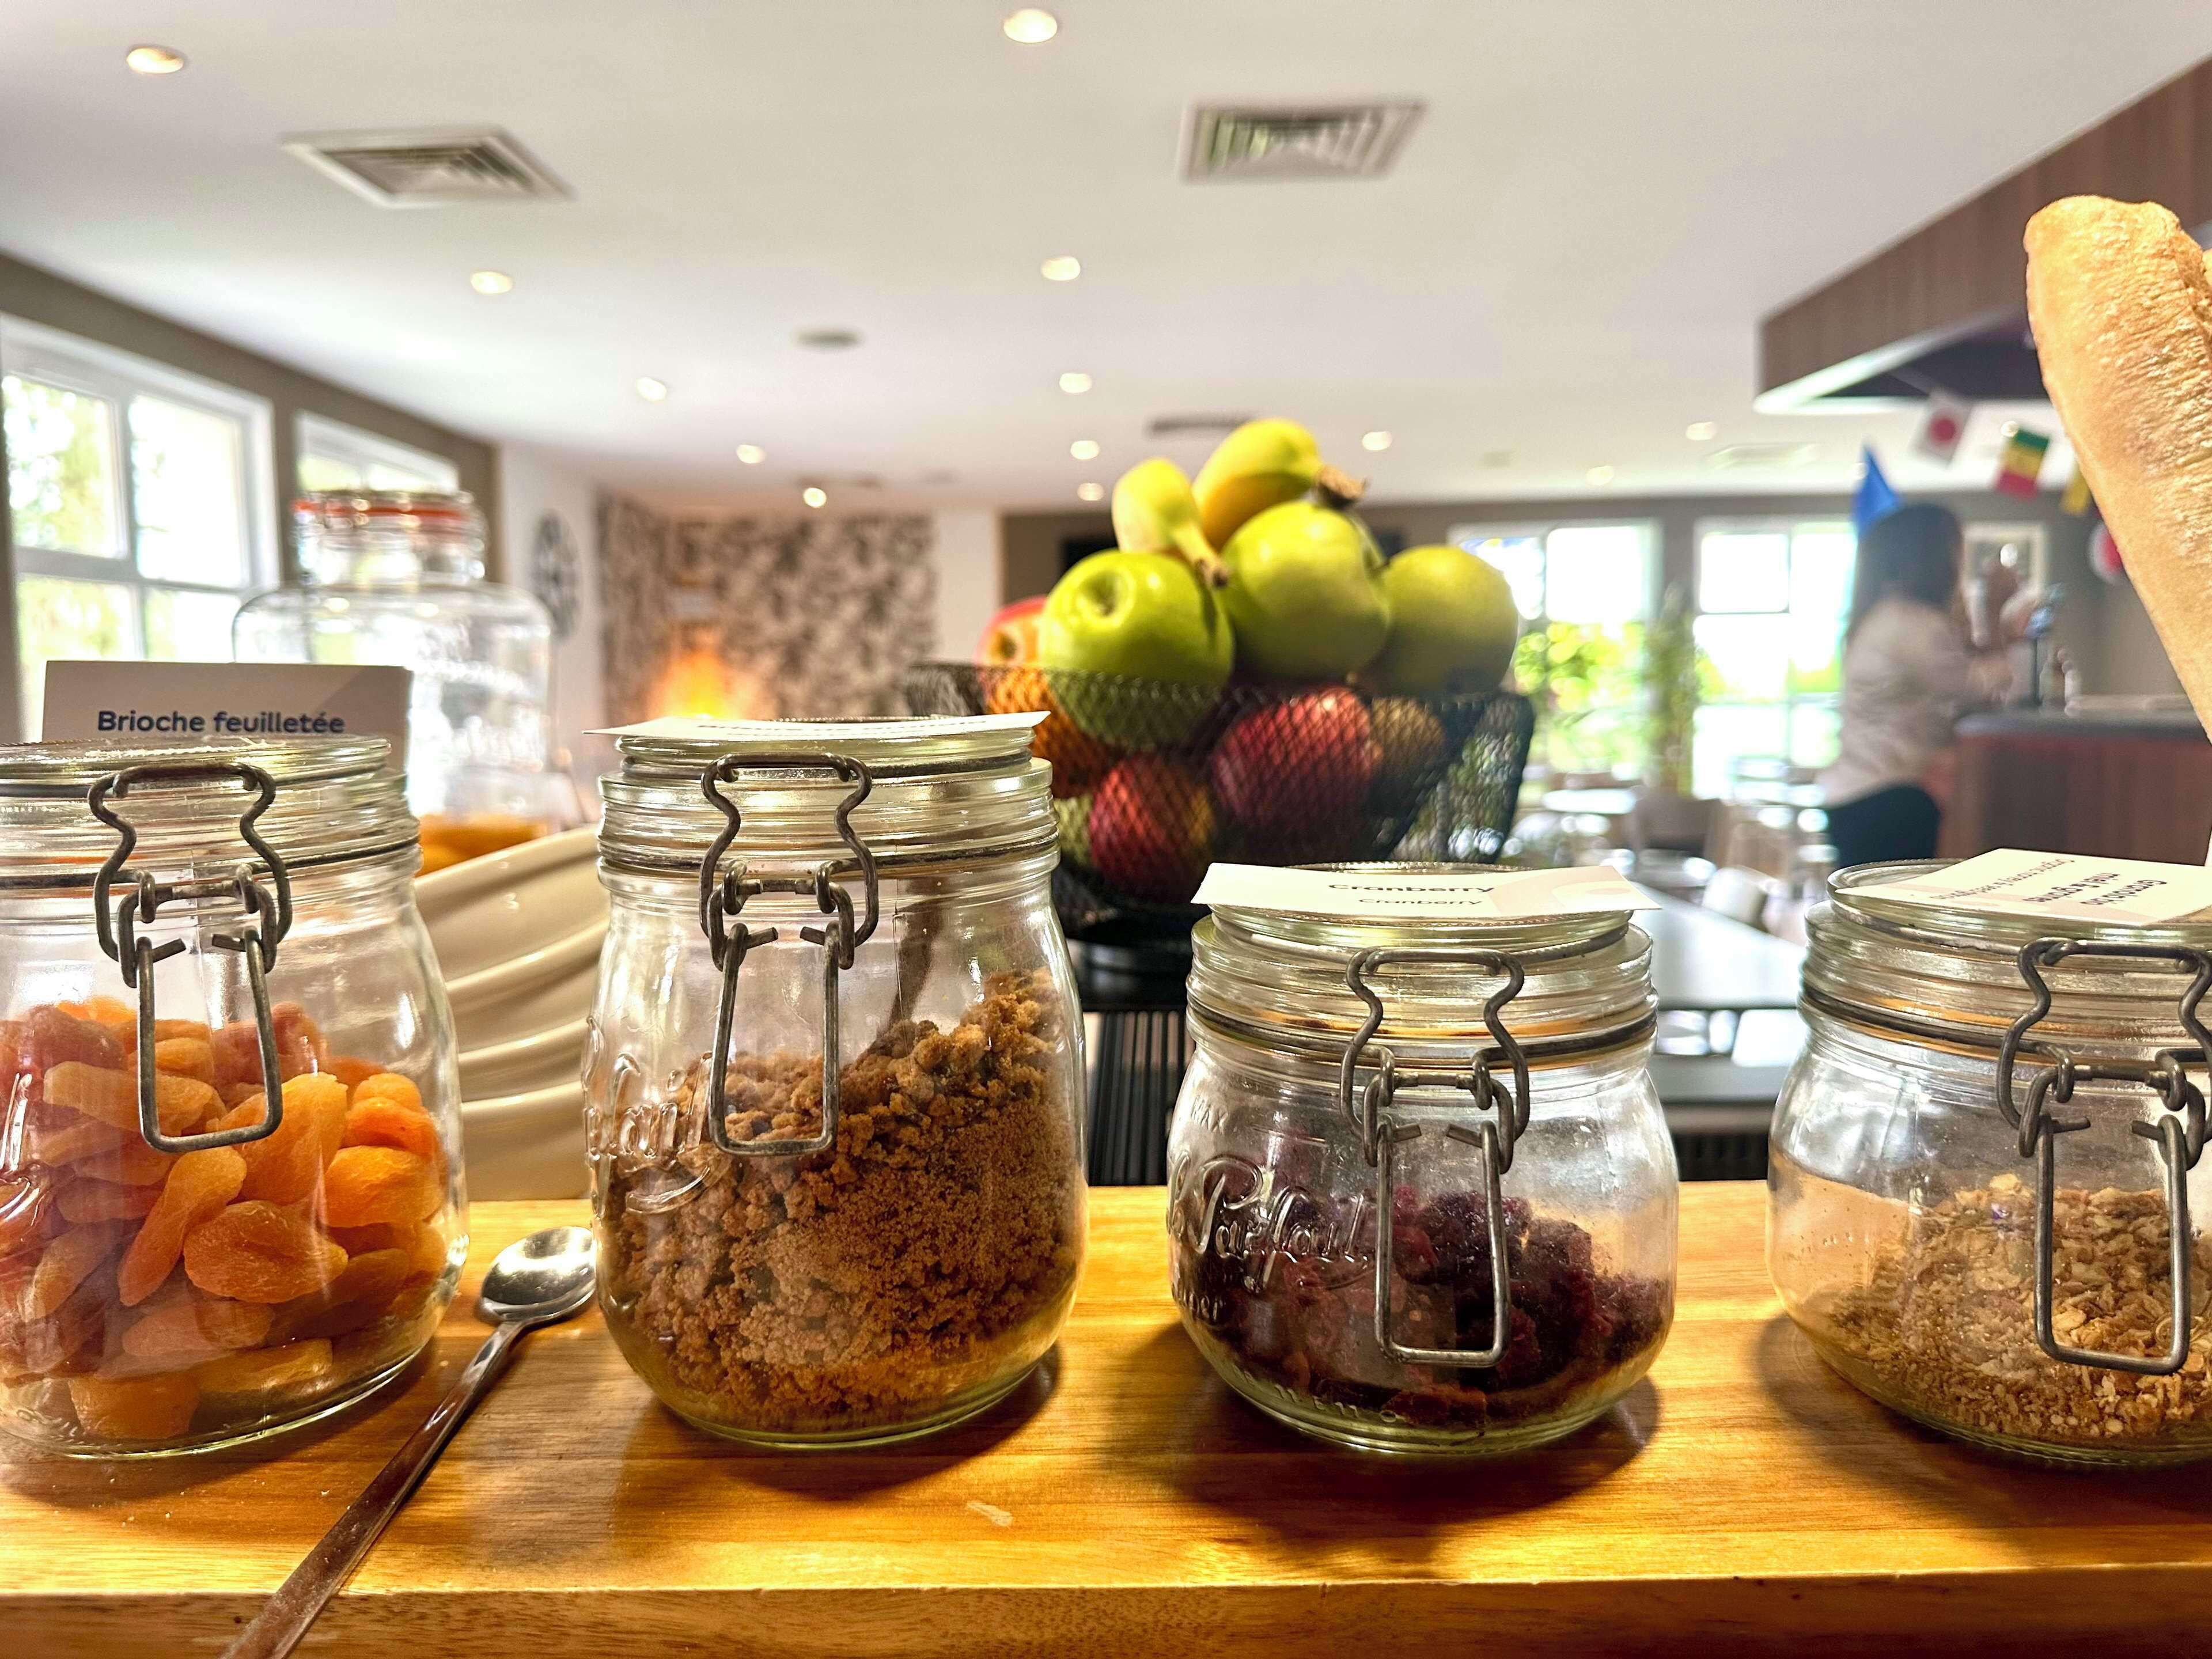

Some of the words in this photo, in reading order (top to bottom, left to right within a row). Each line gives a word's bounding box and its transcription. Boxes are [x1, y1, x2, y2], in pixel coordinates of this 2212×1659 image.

[97, 710, 205, 732] Brioche
[213, 710, 345, 733] feuilletée
[1328, 884, 1495, 893] Cranberry
[2100, 880, 2168, 899] Granola
